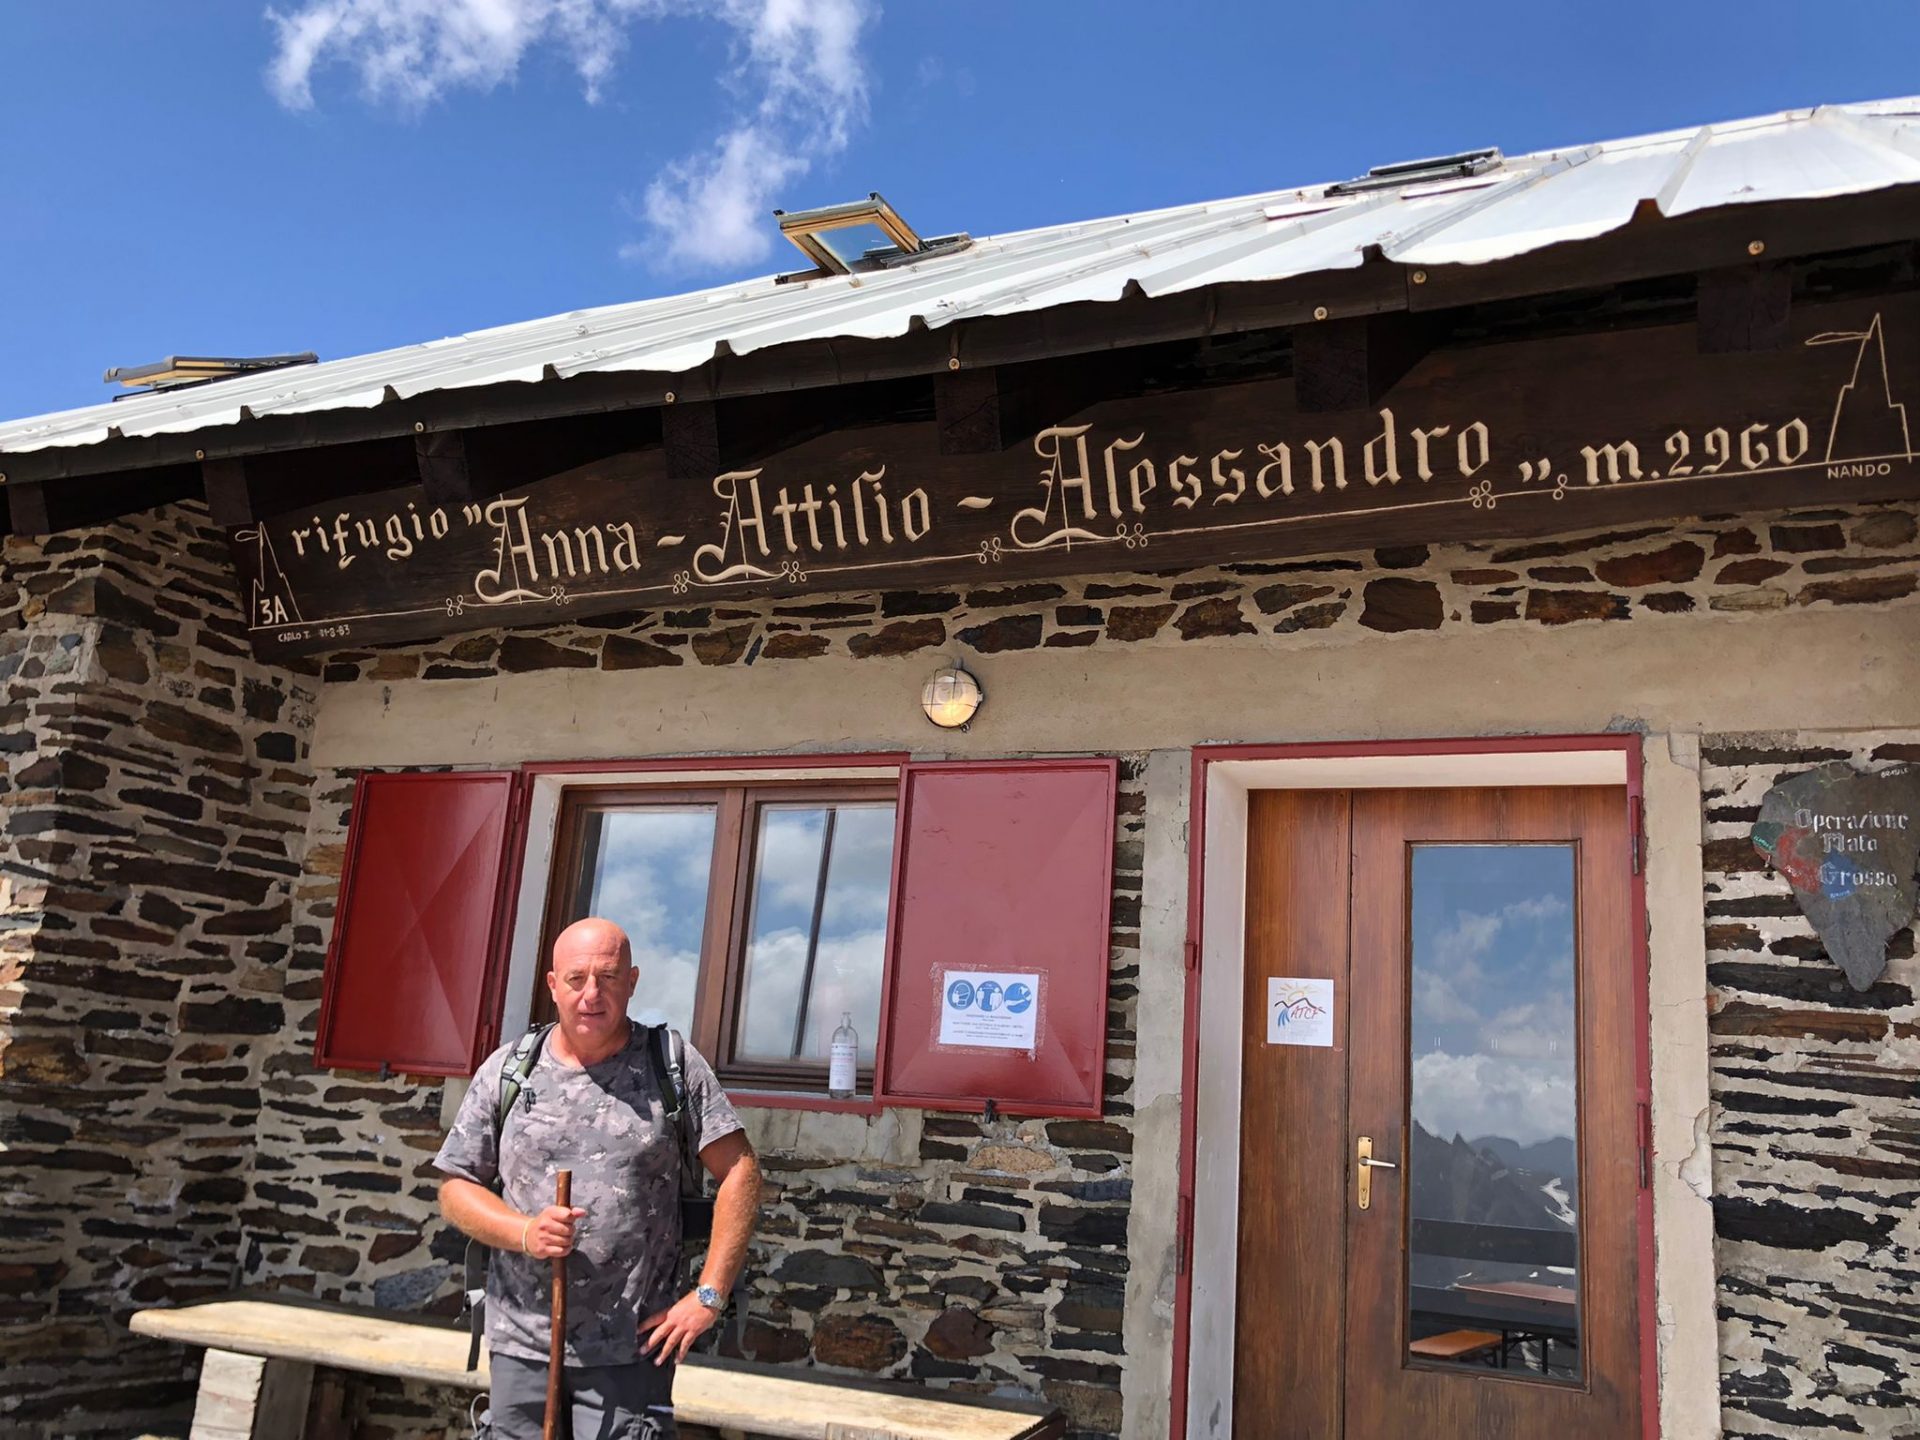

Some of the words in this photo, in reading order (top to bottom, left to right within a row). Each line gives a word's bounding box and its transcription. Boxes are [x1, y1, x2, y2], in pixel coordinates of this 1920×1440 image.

[1827, 462, 1892, 480] NANDO
[291, 501, 449, 570] rifugio
[693, 463, 931, 582] Attilio
[1011, 407, 1490, 551] Alessandro
[259, 594, 290, 625] 3A
[1794, 808, 1909, 833] Operazione
[1820, 832, 1878, 853] Mato
[1819, 861, 1898, 887] Grosso
